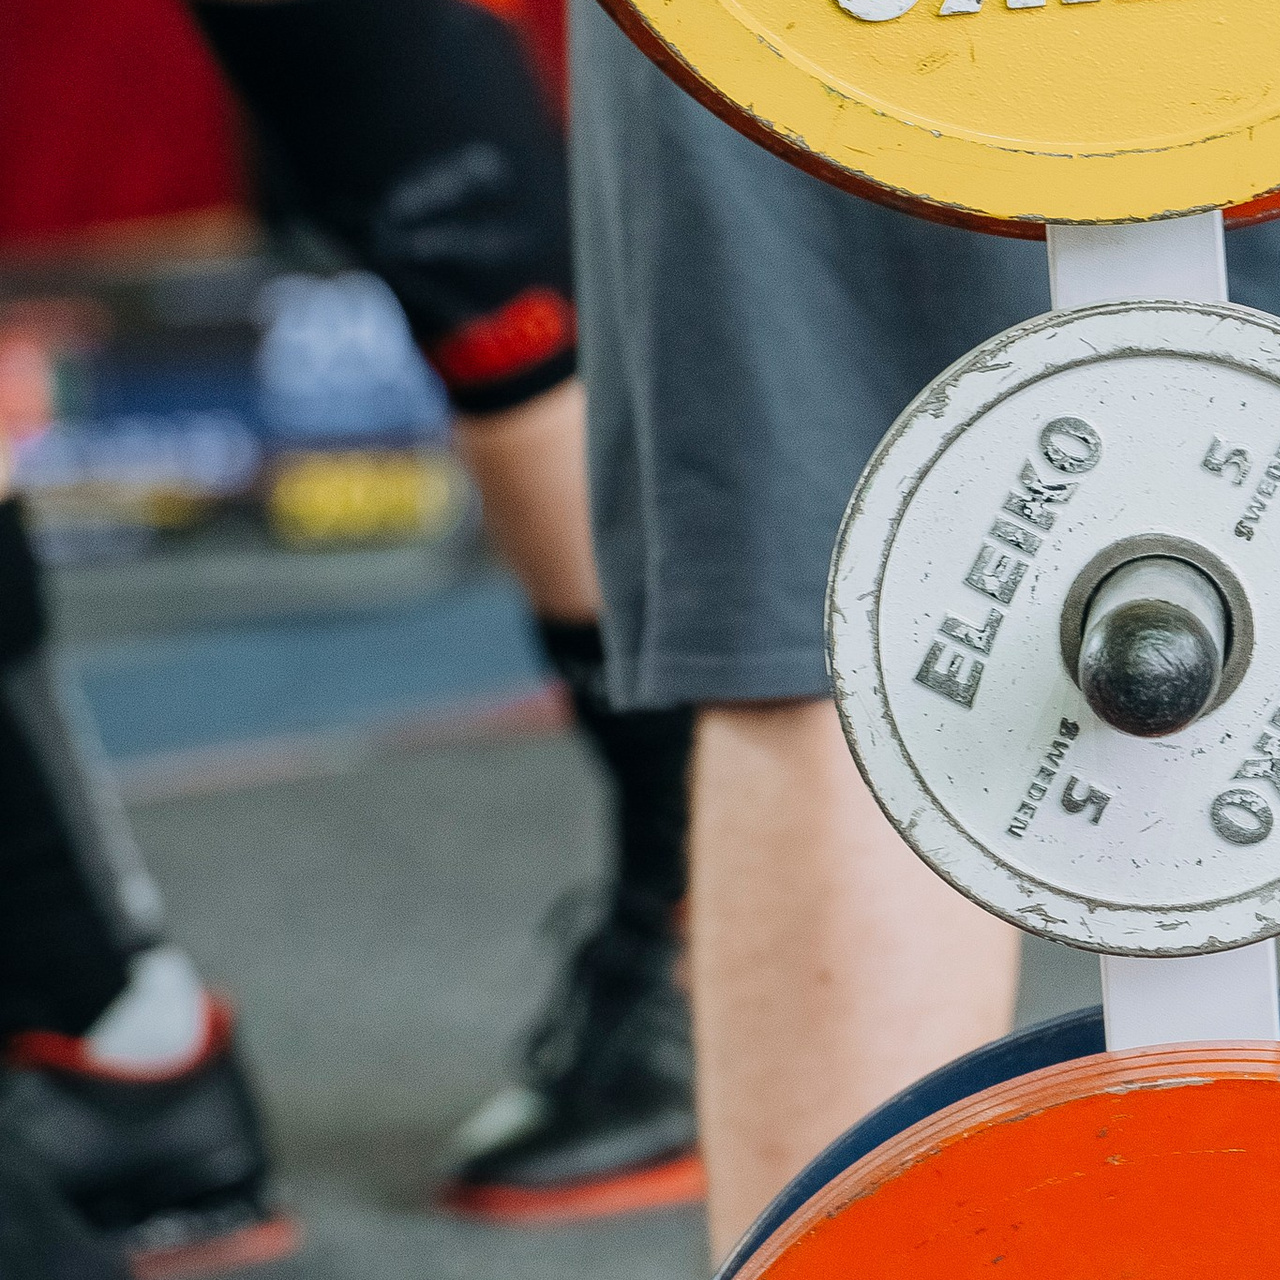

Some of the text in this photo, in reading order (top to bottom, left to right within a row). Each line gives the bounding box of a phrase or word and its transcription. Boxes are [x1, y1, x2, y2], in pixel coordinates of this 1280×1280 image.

[1202, 435, 1253, 485] 5
[914, 416, 1102, 708] ELEIKO
[1008, 718, 1079, 838] SWEDEN
[1062, 775, 1112, 825] 5
